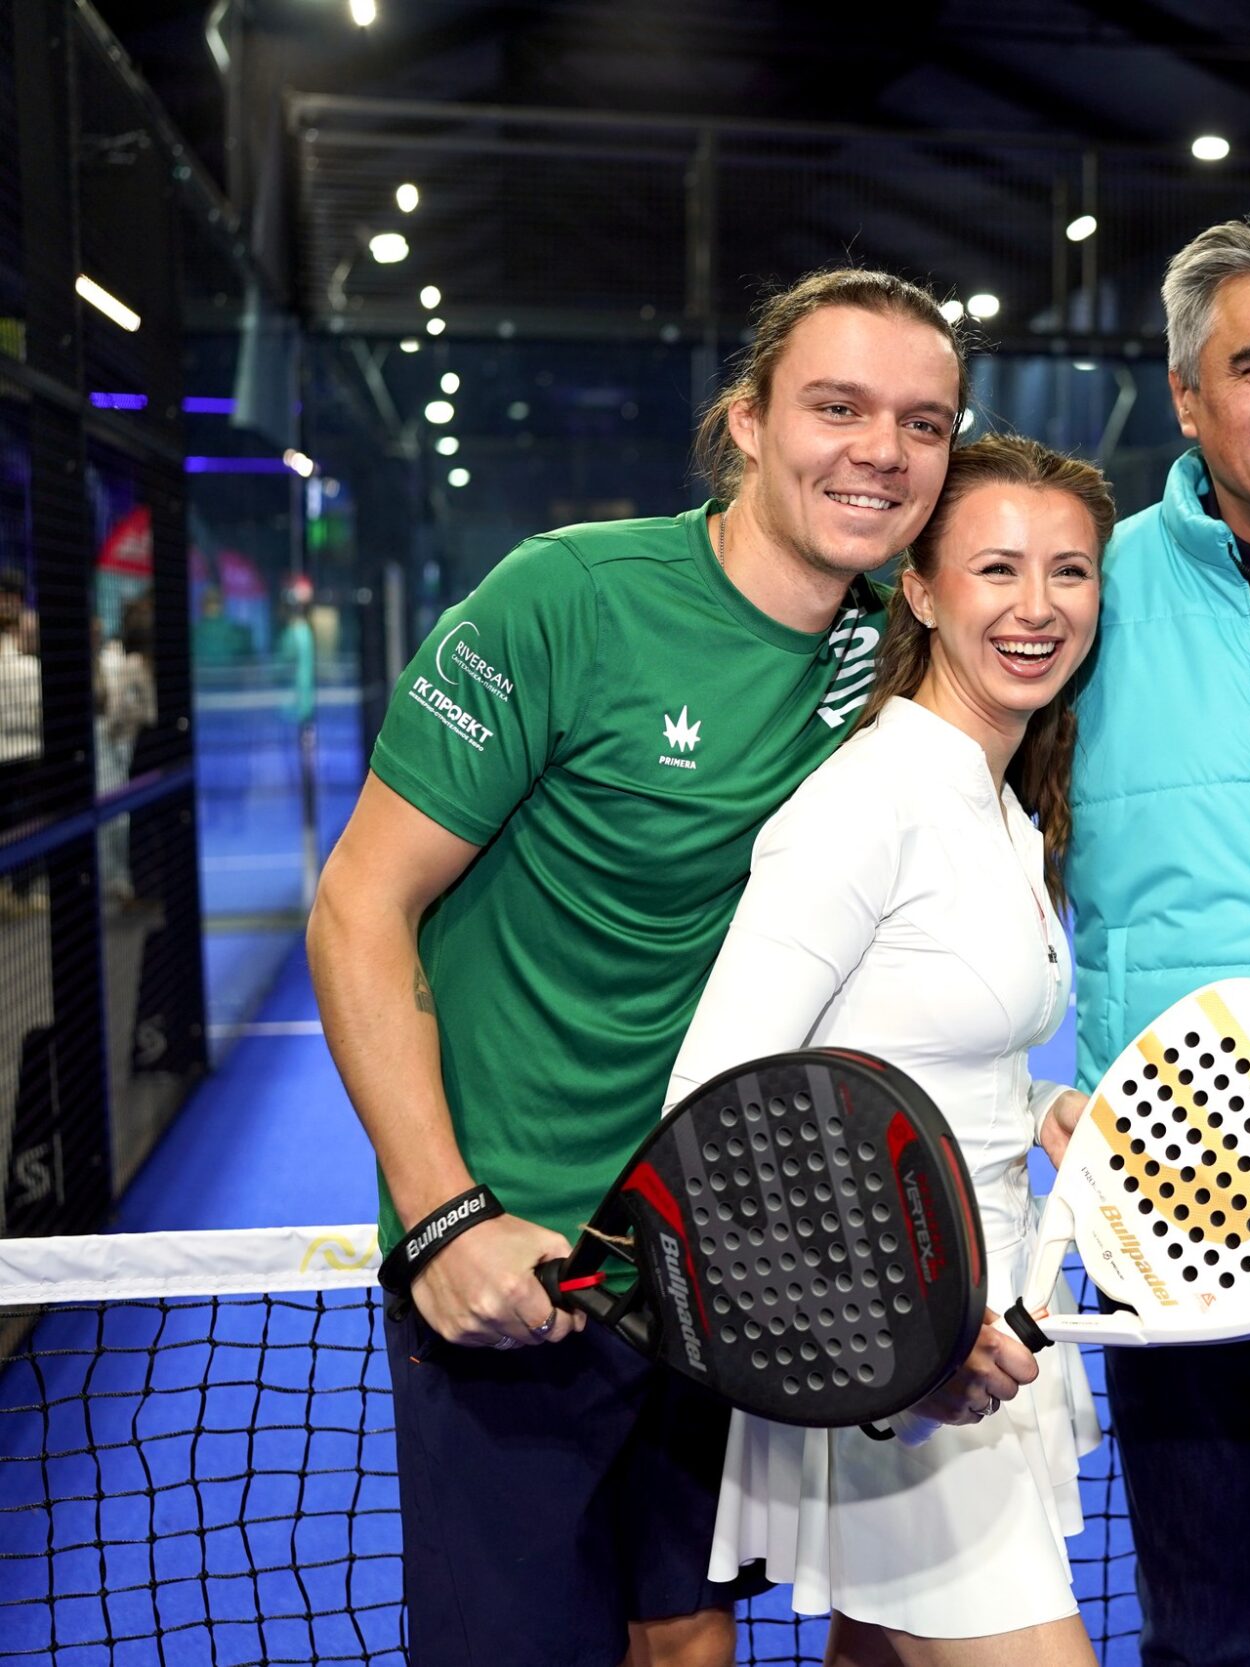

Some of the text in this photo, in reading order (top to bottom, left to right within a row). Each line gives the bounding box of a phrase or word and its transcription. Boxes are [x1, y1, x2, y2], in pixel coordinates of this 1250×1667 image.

[455, 640, 513, 694] RIVERSAN
[483, 681, 508, 702] ПЛИТКА
[413, 676, 494, 743] ГК ПРОЕКТ
[659, 755, 696, 769] PRIMERA
[406, 1192, 486, 1262] Bullpadel
[903, 1169, 934, 1258] VERTEX
[1099, 1205, 1178, 1306] Bullpadel
[659, 1232, 707, 1372] Bullpadel
